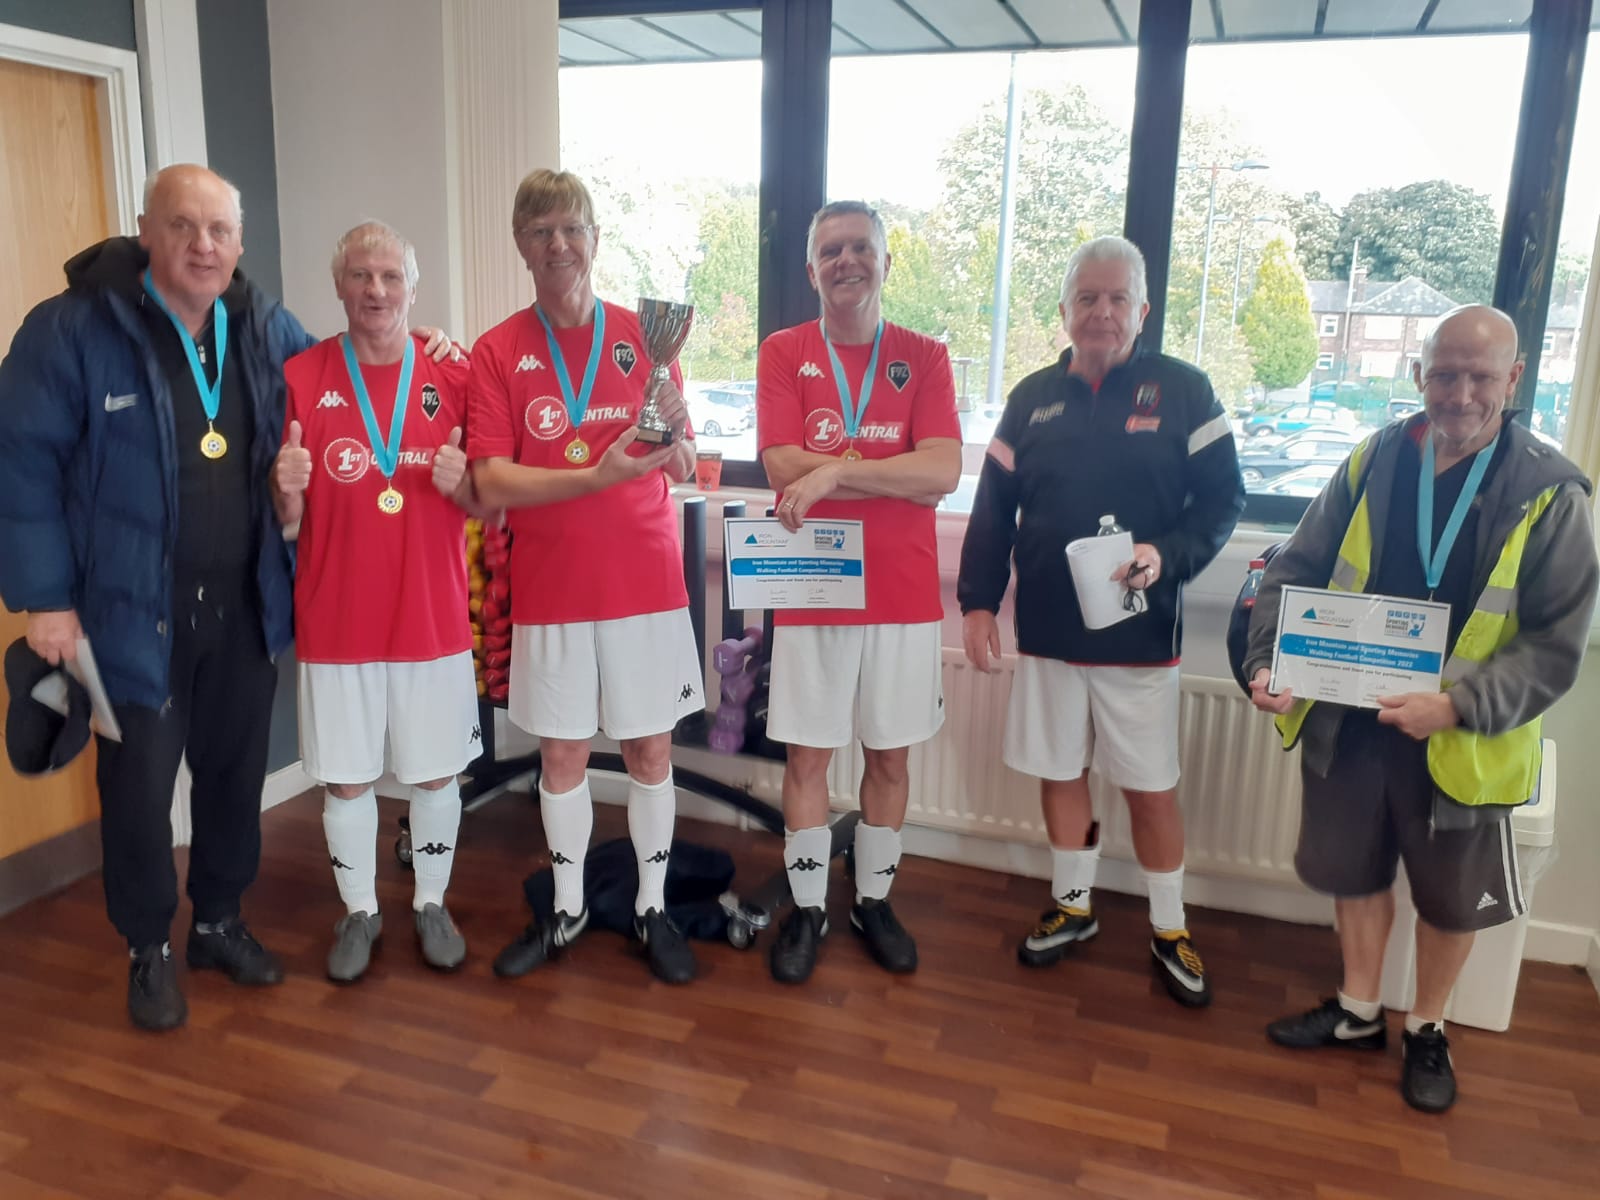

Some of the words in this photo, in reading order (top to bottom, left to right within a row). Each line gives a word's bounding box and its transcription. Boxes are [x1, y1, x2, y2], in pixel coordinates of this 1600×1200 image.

[581, 406, 630, 422] NTRAL
[844, 425, 900, 439] NTRAL
[370, 451, 429, 465] CTRAL
